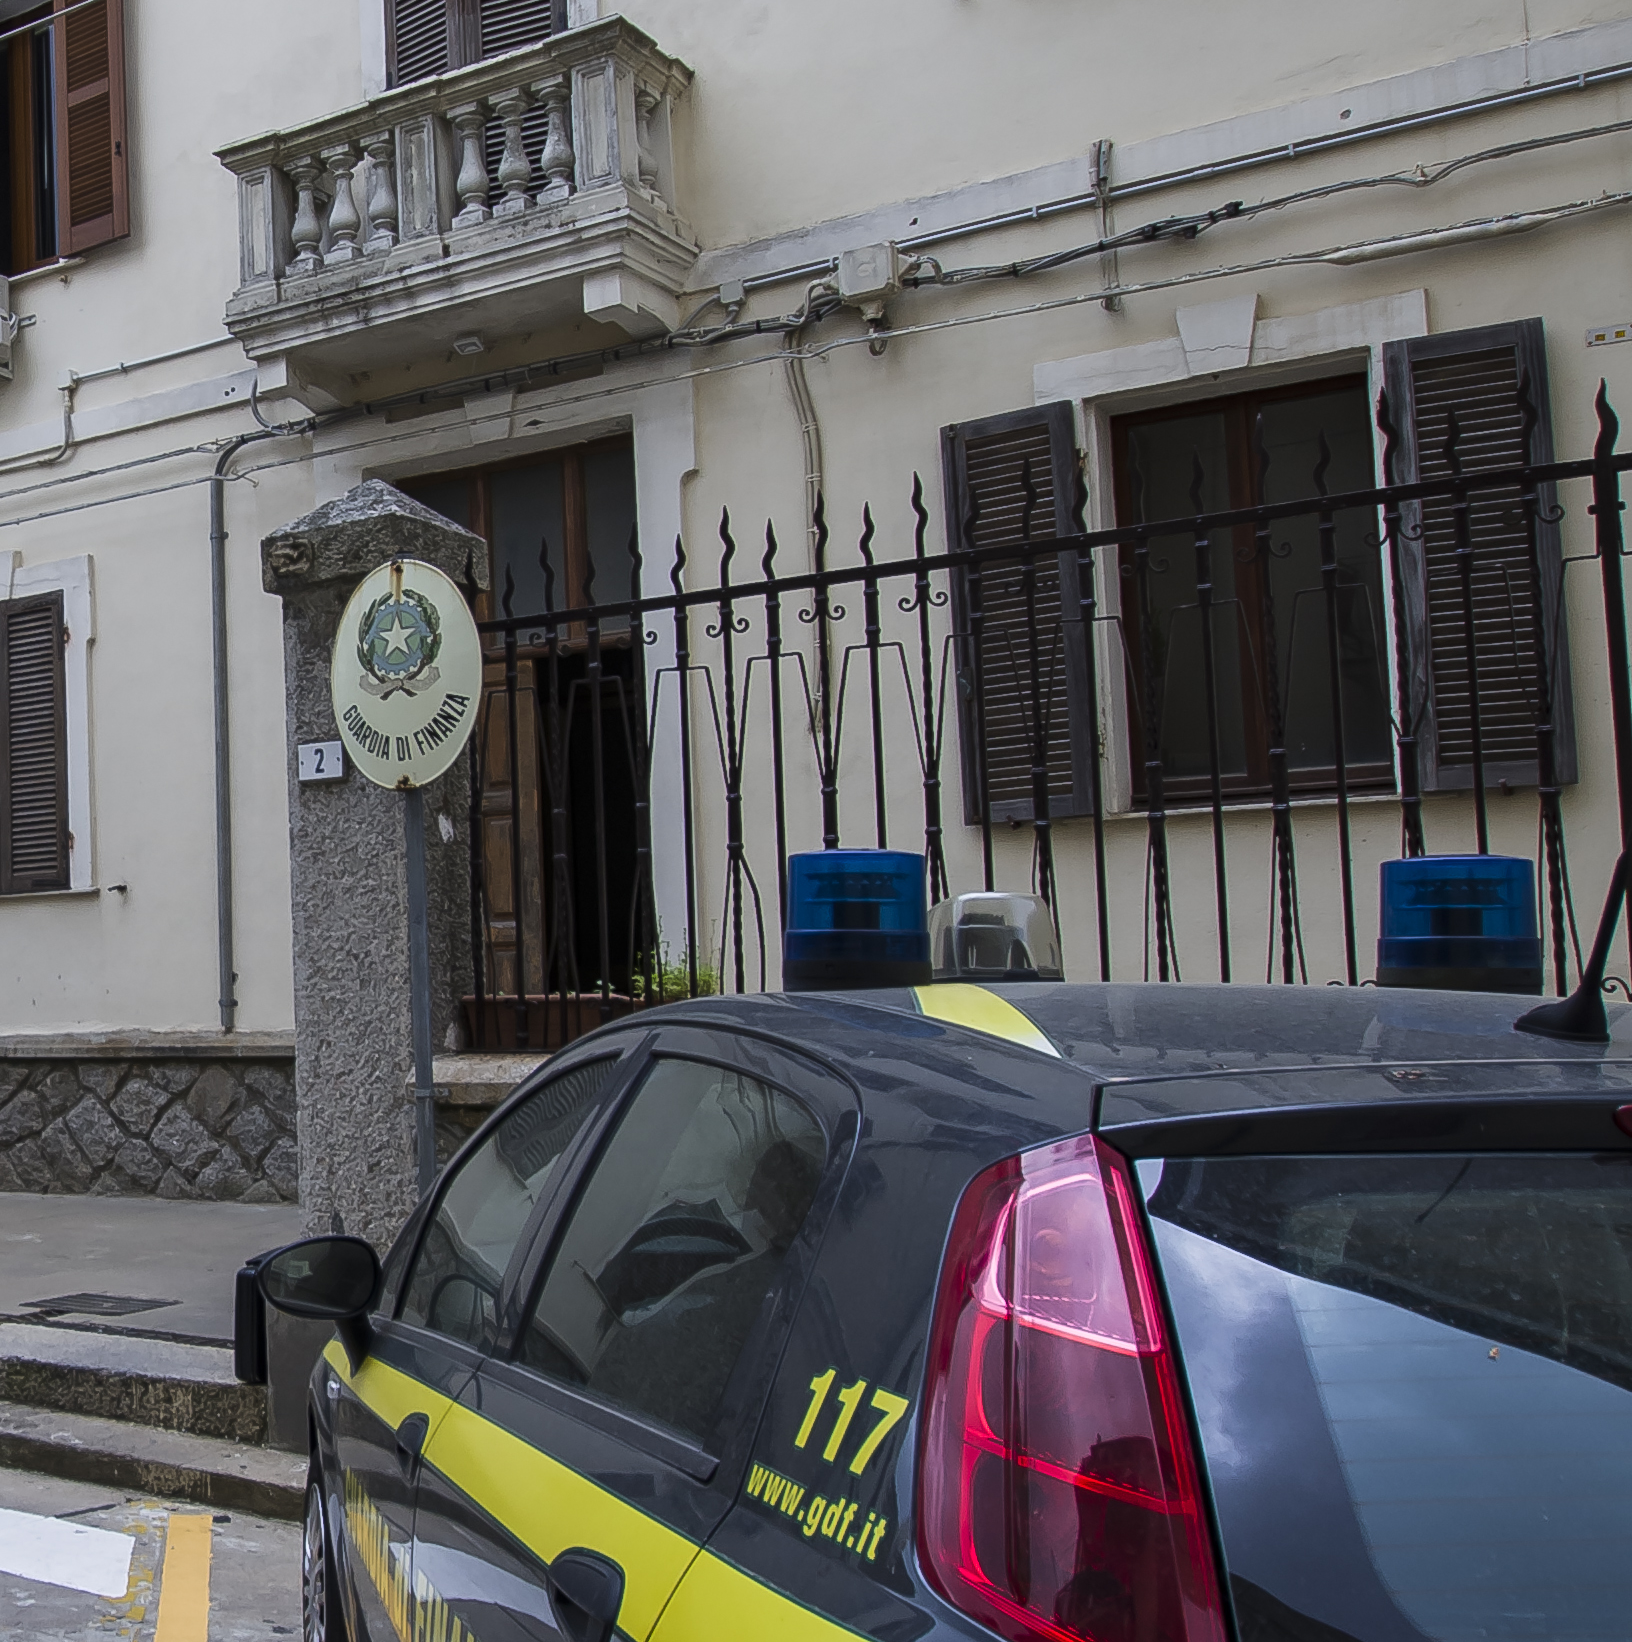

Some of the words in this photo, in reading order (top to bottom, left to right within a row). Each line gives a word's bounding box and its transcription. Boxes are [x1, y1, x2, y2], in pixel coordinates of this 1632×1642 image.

[313, 747, 326, 774] 2
[342, 703, 391, 761] GUARDIA
[395, 735, 413, 762] DI
[412, 692, 471, 756] FINANZA
[794, 1367, 910, 1476] 117
[746, 1463, 887, 1561] www.gdf.it
